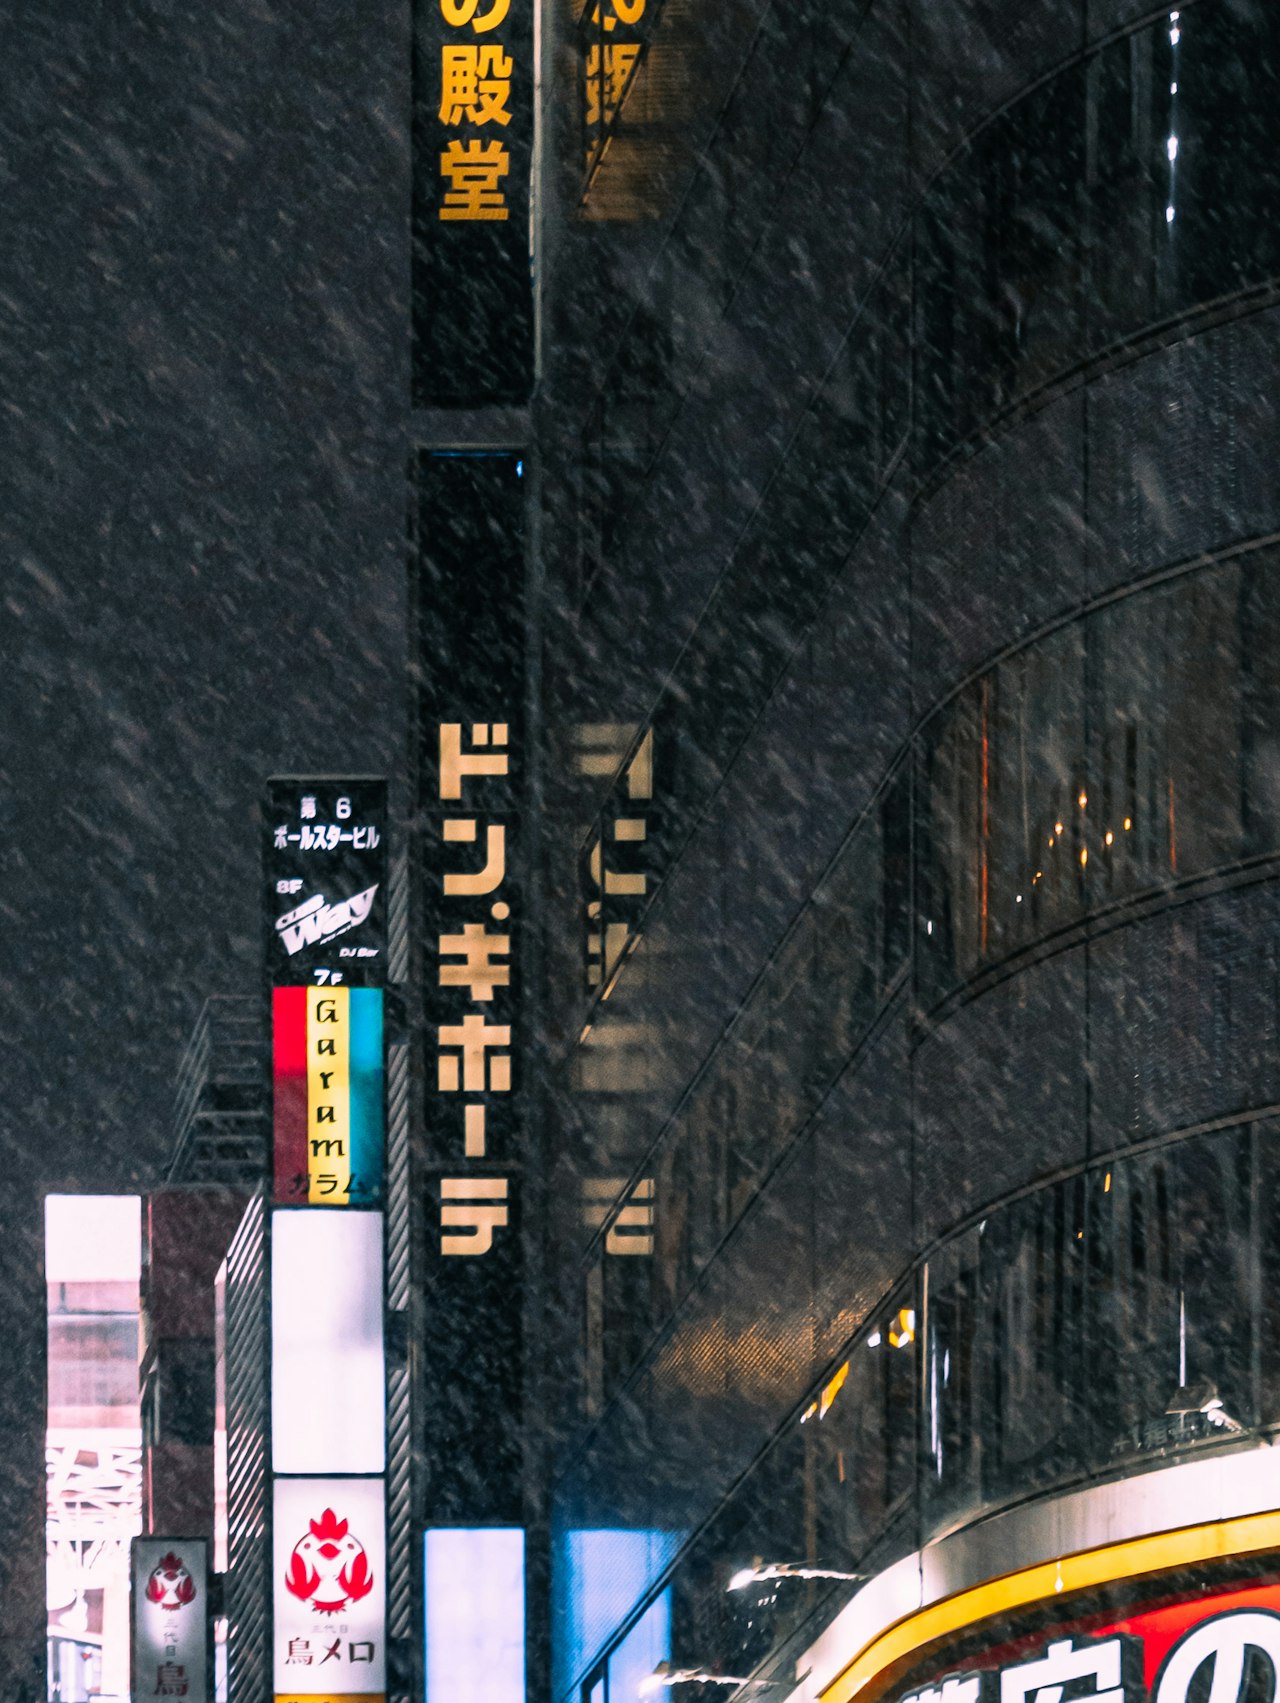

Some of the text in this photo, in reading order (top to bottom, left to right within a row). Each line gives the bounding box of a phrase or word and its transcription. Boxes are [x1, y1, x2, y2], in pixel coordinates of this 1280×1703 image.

[314, 969, 343, 985] 7F
[310, 1000, 346, 1157] Garam
[289, 1174, 368, 1196] ガラム
[285, 1637, 376, 1666] 鳥メロ
